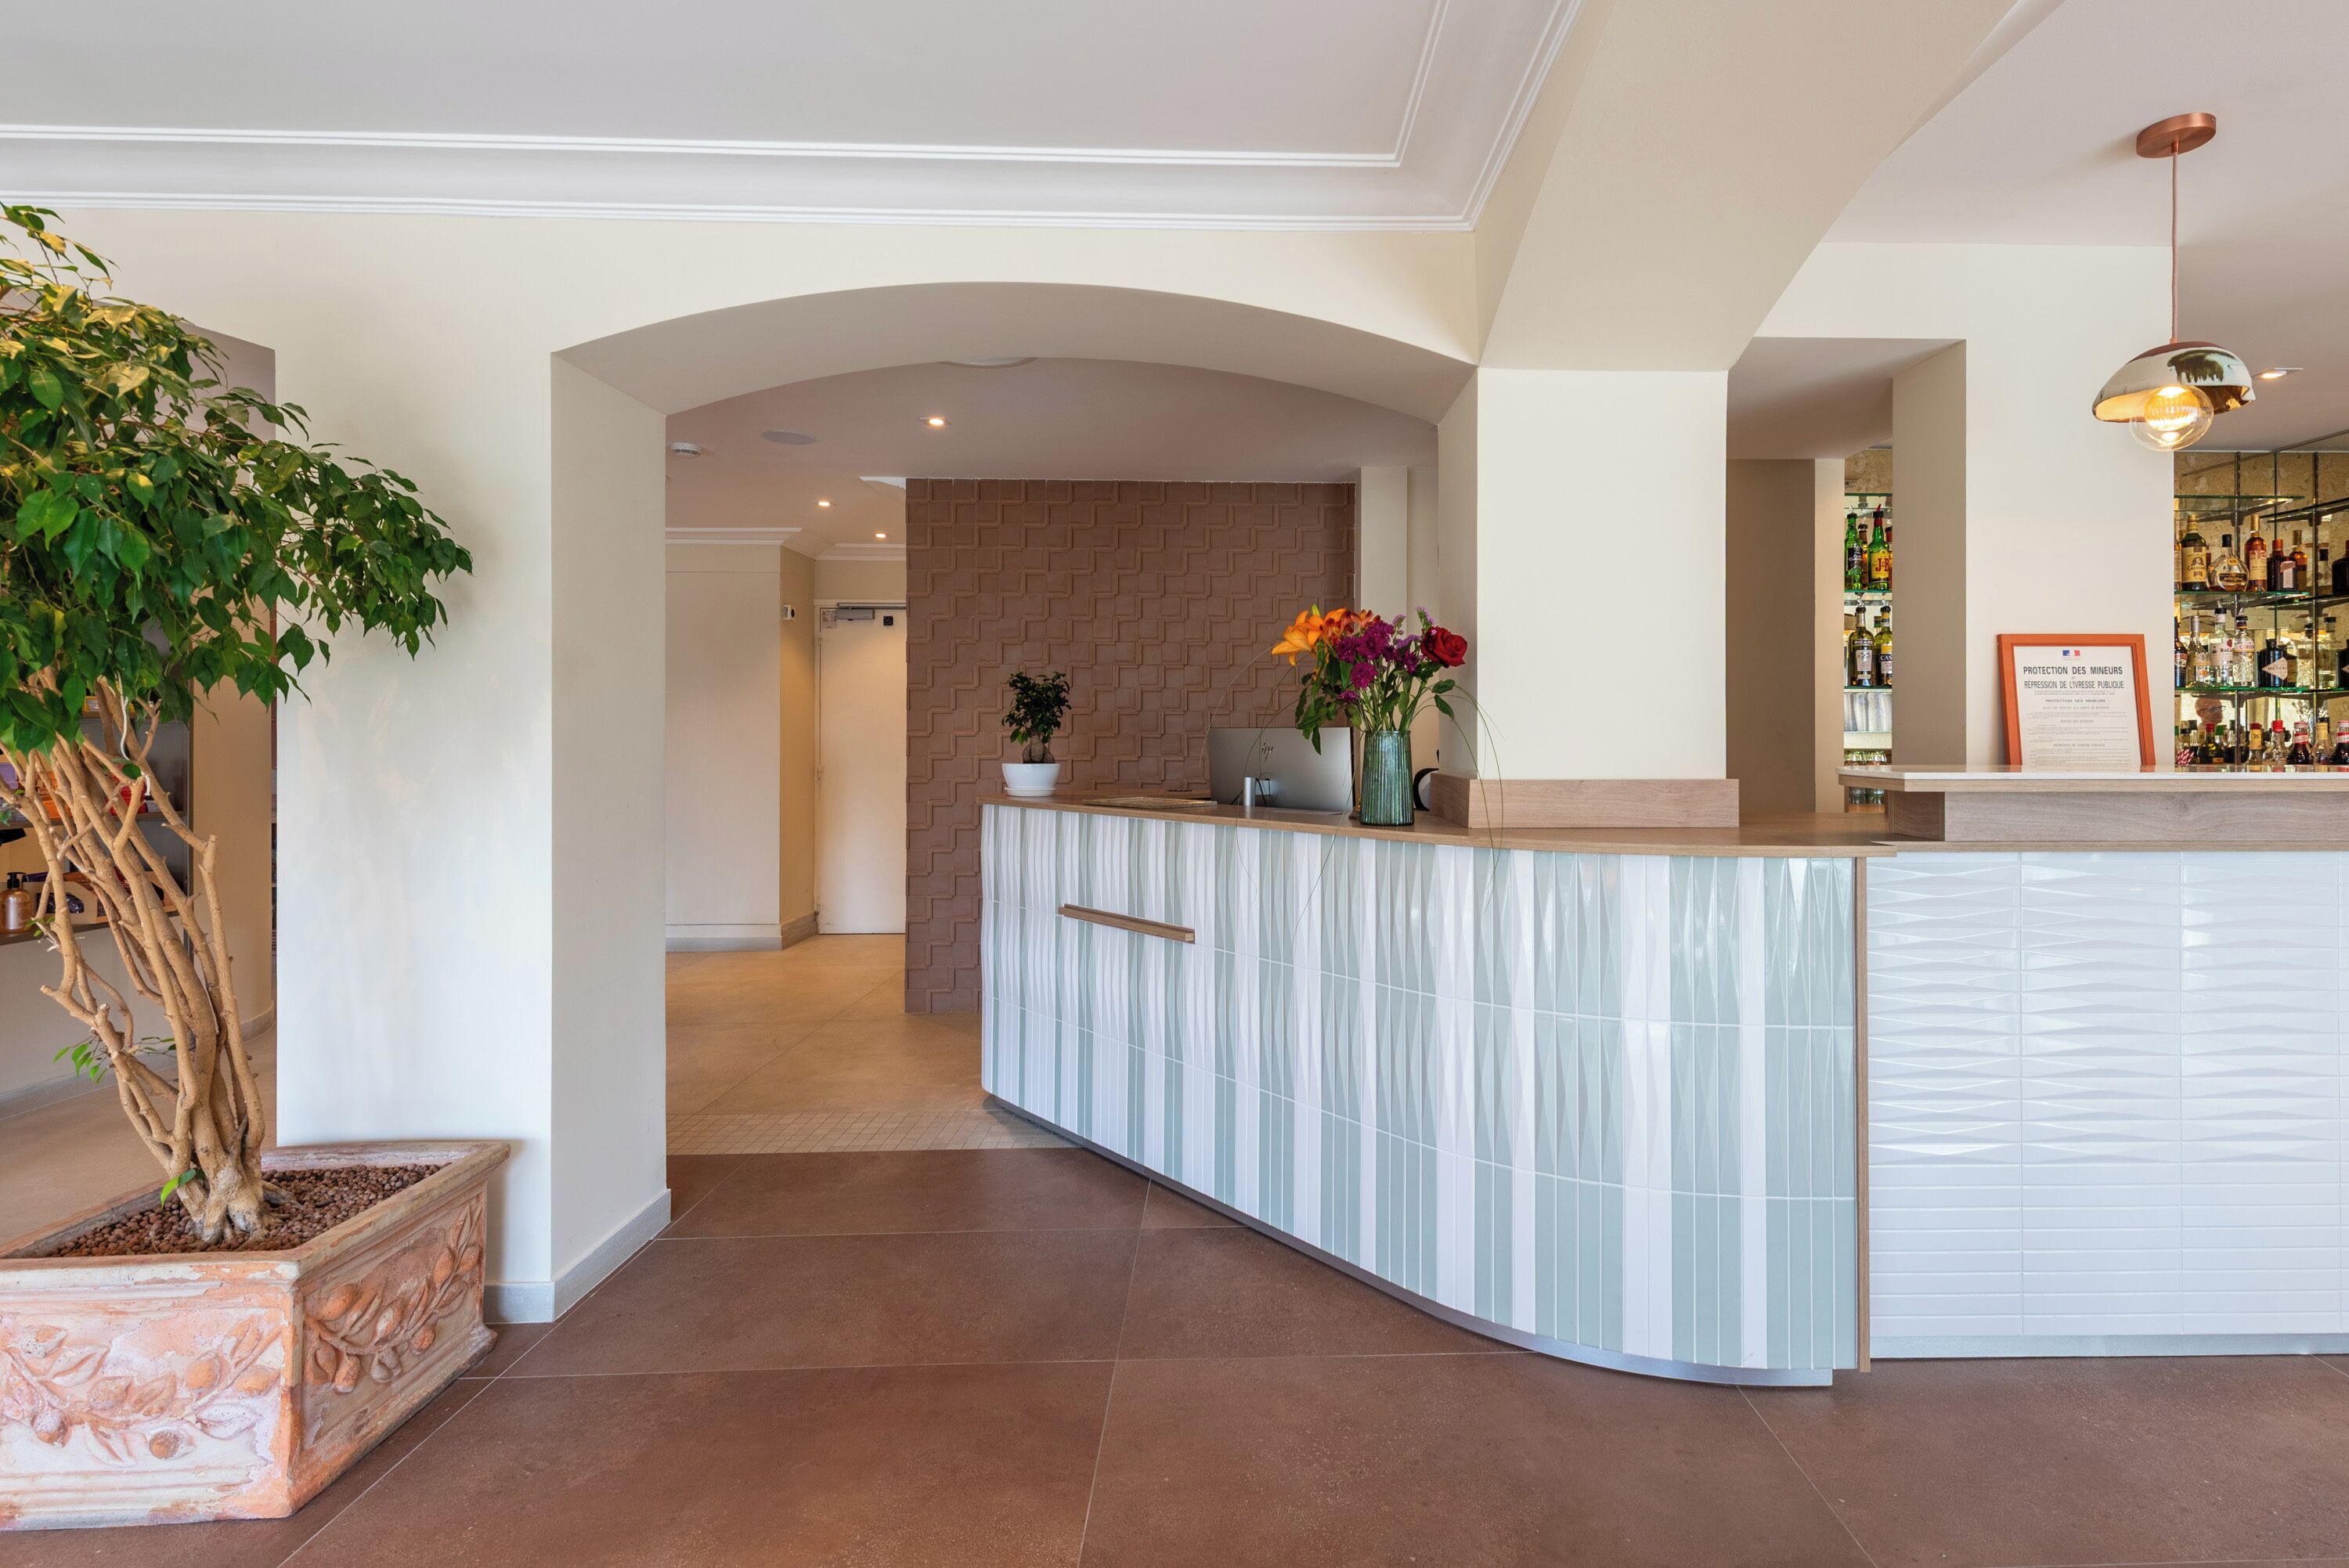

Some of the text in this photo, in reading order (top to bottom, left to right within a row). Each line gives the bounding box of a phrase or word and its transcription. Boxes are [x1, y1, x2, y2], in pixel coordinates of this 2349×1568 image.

[2023, 666, 2123, 675] PROTECTION DES MINEURS
[2059, 680, 2067, 689] DE
[2069, 680, 2095, 689] L'IVRESSE
[2098, 680, 2124, 689] PUBLIQUE
